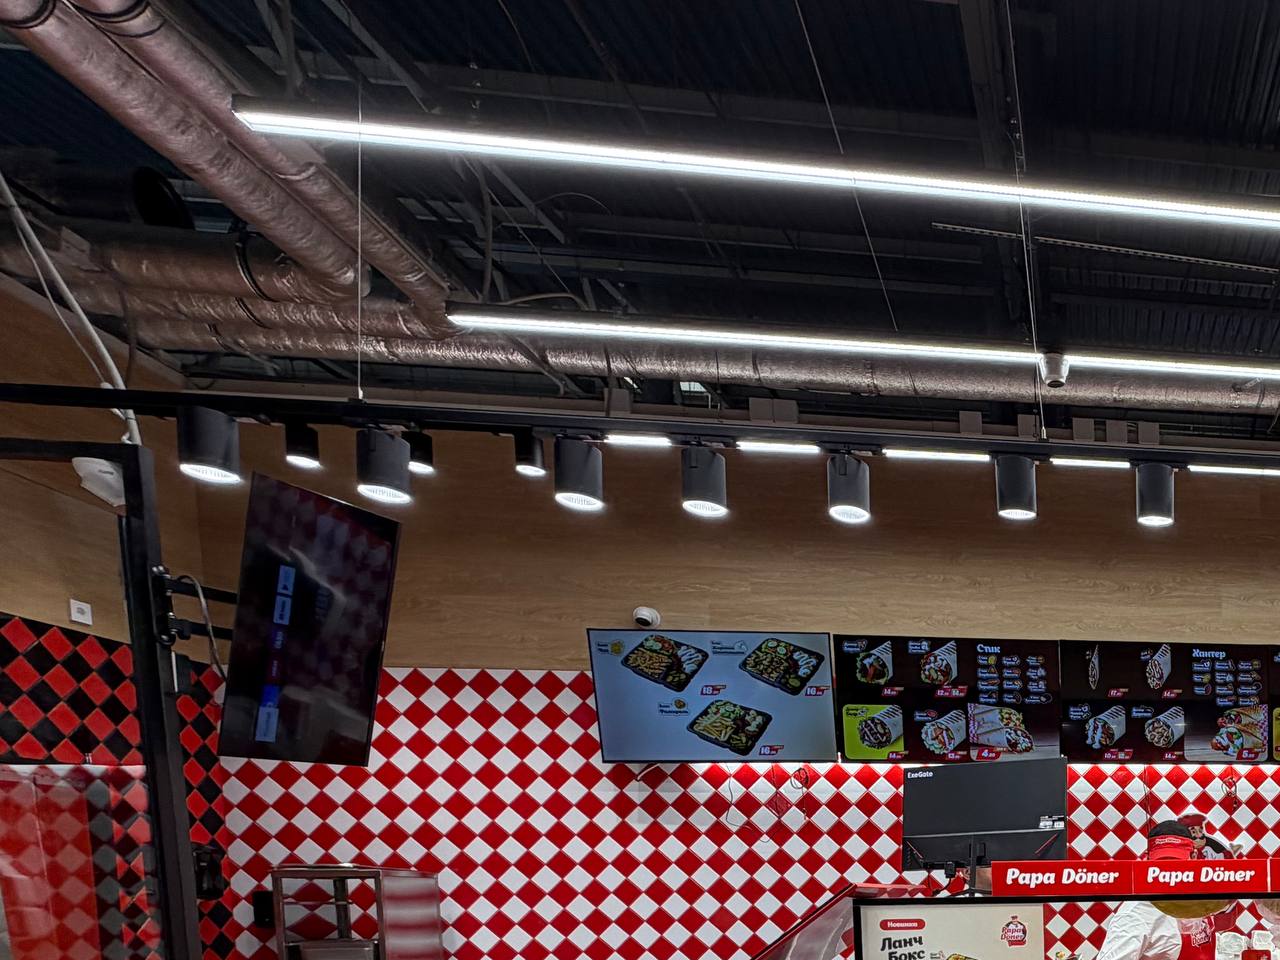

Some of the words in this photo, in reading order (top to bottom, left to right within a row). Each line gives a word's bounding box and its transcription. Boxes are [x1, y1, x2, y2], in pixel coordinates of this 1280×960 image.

[907, 771, 934, 779] ExeGate
[1006, 868, 1055, 888] Papa
[1061, 868, 1119, 884] Döner
[1147, 866, 1194, 886] Papa
[1200, 866, 1255, 882] Döner
[880, 936, 924, 951] Ланч
